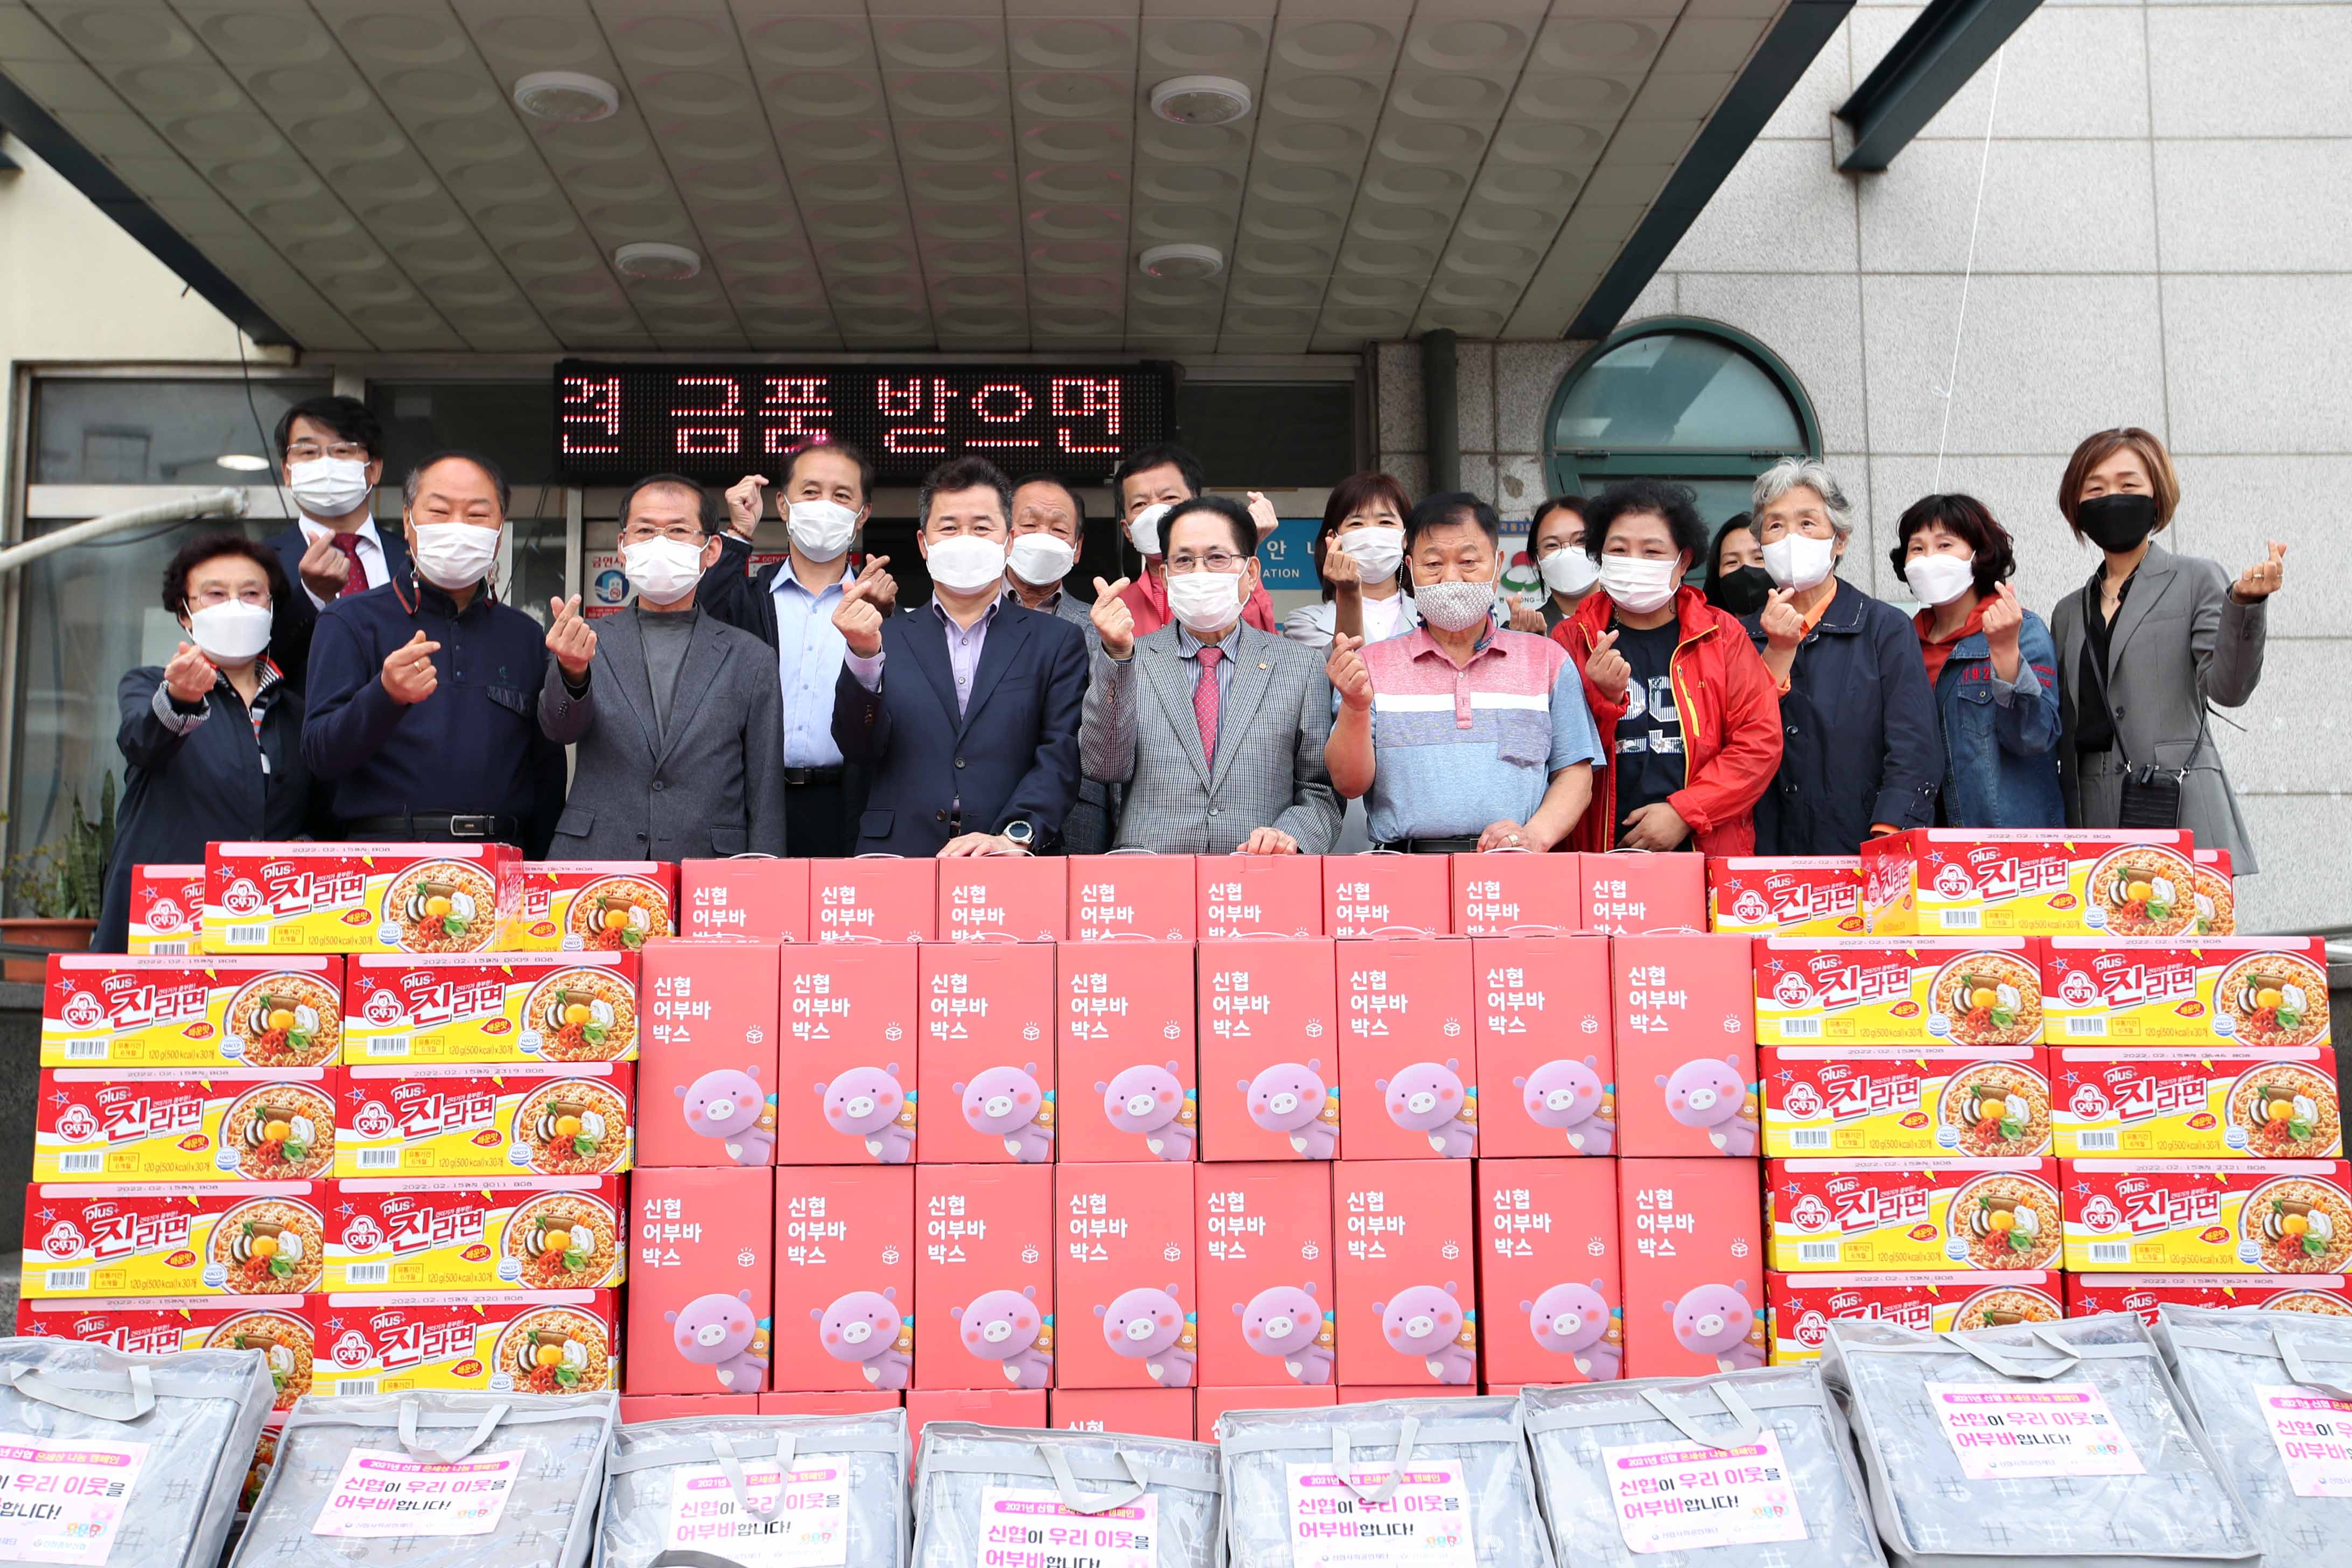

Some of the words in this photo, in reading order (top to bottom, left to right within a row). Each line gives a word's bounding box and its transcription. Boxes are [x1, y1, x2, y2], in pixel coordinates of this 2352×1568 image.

[671, 378, 834, 454] 금품
[877, 378, 1122, 454] 받으면
[1262, 569, 1299, 578] ATION
[1593, 880, 1626, 898] 신협
[1941, 881, 1966, 892] 오뚜기
[1977, 858, 2069, 900] 진라면
[230, 896, 256, 907] 오뚜기
[268, 872, 365, 915] 진라면
[694, 887, 726, 905] 신협
[1209, 883, 1241, 901] 신협
[347, 912, 368, 923] 매운맛
[693, 909, 746, 927] 어부바
[952, 908, 1005, 925] 어부바
[1209, 905, 1261, 922] 어부바
[1594, 902, 1646, 920] 어부바
[655, 976, 690, 996] 신협
[794, 974, 829, 993] 신협
[932, 974, 967, 993] 신협
[1071, 973, 1107, 993] 신협
[1213, 971, 1248, 991] 신협
[1350, 970, 1386, 990] 신협
[1487, 968, 1523, 988] 신협
[1629, 966, 1665, 986] 신협
[2102, 965, 2196, 1007] 진라면
[1781, 989, 1806, 1000] 오뚜기
[1817, 965, 1911, 1008] 진라면
[2066, 988, 2091, 999] 오뚜기
[109, 985, 207, 1029] 진라면
[409, 982, 505, 1025] 진라면
[793, 998, 850, 1018] 어부바
[931, 998, 988, 1018] 어부바
[1072, 997, 1128, 1017] 어부바
[1213, 995, 1270, 1015] 어부바
[1351, 994, 1408, 1014] 어부바
[1488, 991, 1545, 1011] 어부바
[1630, 990, 1687, 1010] 어부바
[1895, 1004, 1916, 1016] 매운맛
[370, 1007, 396, 1018] 오뚜기
[654, 1001, 711, 1021] 어부바
[487, 1021, 508, 1033] 매운맛
[793, 1022, 830, 1041] 박스
[931, 1021, 968, 1040] 박스
[1072, 1021, 1109, 1040] 박스
[1214, 1019, 1251, 1039] 박스
[1352, 1019, 1389, 1037] 박스
[1489, 1016, 1526, 1035] 박스
[1630, 1014, 1668, 1033] 박스
[654, 1025, 690, 1044] 박스
[1828, 1076, 1921, 1119] 진라면
[2077, 1101, 2102, 1112] 오뚜기
[2113, 1077, 2208, 1120] 진라면
[103, 1097, 202, 1142] 진라면
[361, 1119, 387, 1130] 오뚜기
[399, 1094, 495, 1137] 진라면
[1905, 1115, 1926, 1127] 매운맛
[477, 1133, 499, 1145] 매운맛
[644, 1199, 680, 1219] 신협
[788, 1196, 825, 1217] 신협
[928, 1195, 964, 1215] 신협
[1070, 1194, 1106, 1214] 신협
[1208, 1192, 1244, 1212] 신협
[1347, 1191, 1383, 1212] 신협
[1494, 1189, 1529, 1209] 신협
[1636, 1189, 1672, 1209] 신협
[1836, 1188, 1929, 1231] 진라면
[2089, 1213, 2114, 1224] 오뚜기
[2126, 1189, 2221, 1233] 진라면
[388, 1208, 484, 1252] 진라면
[643, 1223, 702, 1243] 어부바
[788, 1221, 846, 1241] 어부바
[928, 1220, 986, 1240] 어부바
[1070, 1219, 1128, 1238] 어부바
[1208, 1216, 1266, 1236] 어부바
[1348, 1216, 1405, 1235] 어부바
[1494, 1213, 1551, 1233] 어부바
[1637, 1214, 1695, 1233] 어부바
[90, 1214, 190, 1258] 진라면
[350, 1234, 376, 1245] 오뚜기
[2205, 1230, 2227, 1242] 매운맛
[466, 1248, 488, 1259] 매운맛
[643, 1248, 681, 1268] 박스
[788, 1246, 826, 1265] 박스
[928, 1245, 965, 1264] 박스
[1070, 1243, 1108, 1262] 박스
[1209, 1241, 1246, 1261] 박스
[1348, 1241, 1386, 1260] 박스
[1495, 1238, 1532, 1258] 박스
[1638, 1238, 1676, 1258] 박스
[339, 1349, 365, 1361] 오뚜기
[378, 1322, 475, 1368] 진라면
[457, 1363, 479, 1375] 매운맛
[1949, 1411, 2005, 1427] 신협이
[2007, 1411, 2048, 1427] 우리
[2053, 1411, 2109, 1426] 이웃을
[2276, 1419, 2335, 1436] 신협이
[1956, 1431, 2071, 1447] 어부바합니다!
[13, 1474, 59, 1494] 우리
[64, 1477, 124, 1497] 이웃을
[345, 1476, 401, 1493] 신협이
[406, 1478, 445, 1493] 우리
[451, 1479, 507, 1493] 이웃을
[697, 1478, 726, 1488] 2021년
[1619, 1478, 1675, 1497] 신협이
[1678, 1471, 1719, 1489] 우리
[1724, 1466, 1781, 1486] 이웃을
[334, 1495, 451, 1511] 어부바합니다!
[680, 1499, 734, 1518] 신협이
[786, 1492, 840, 1509] 이웃을
[1005, 1502, 1034, 1512] 2021년
[1298, 1498, 1354, 1515] 신협이
[1404, 1495, 1460, 1512] 이웃을
[1623, 1496, 1740, 1520] 어부바합니다!
[677, 1521, 792, 1542] 어부바합니다!
[988, 1524, 1043, 1544] 신협이
[1048, 1528, 1087, 1547] 우리
[1094, 1530, 1150, 1550] 이웃을
[1299, 1520, 1414, 1539] 어부바합니다!
